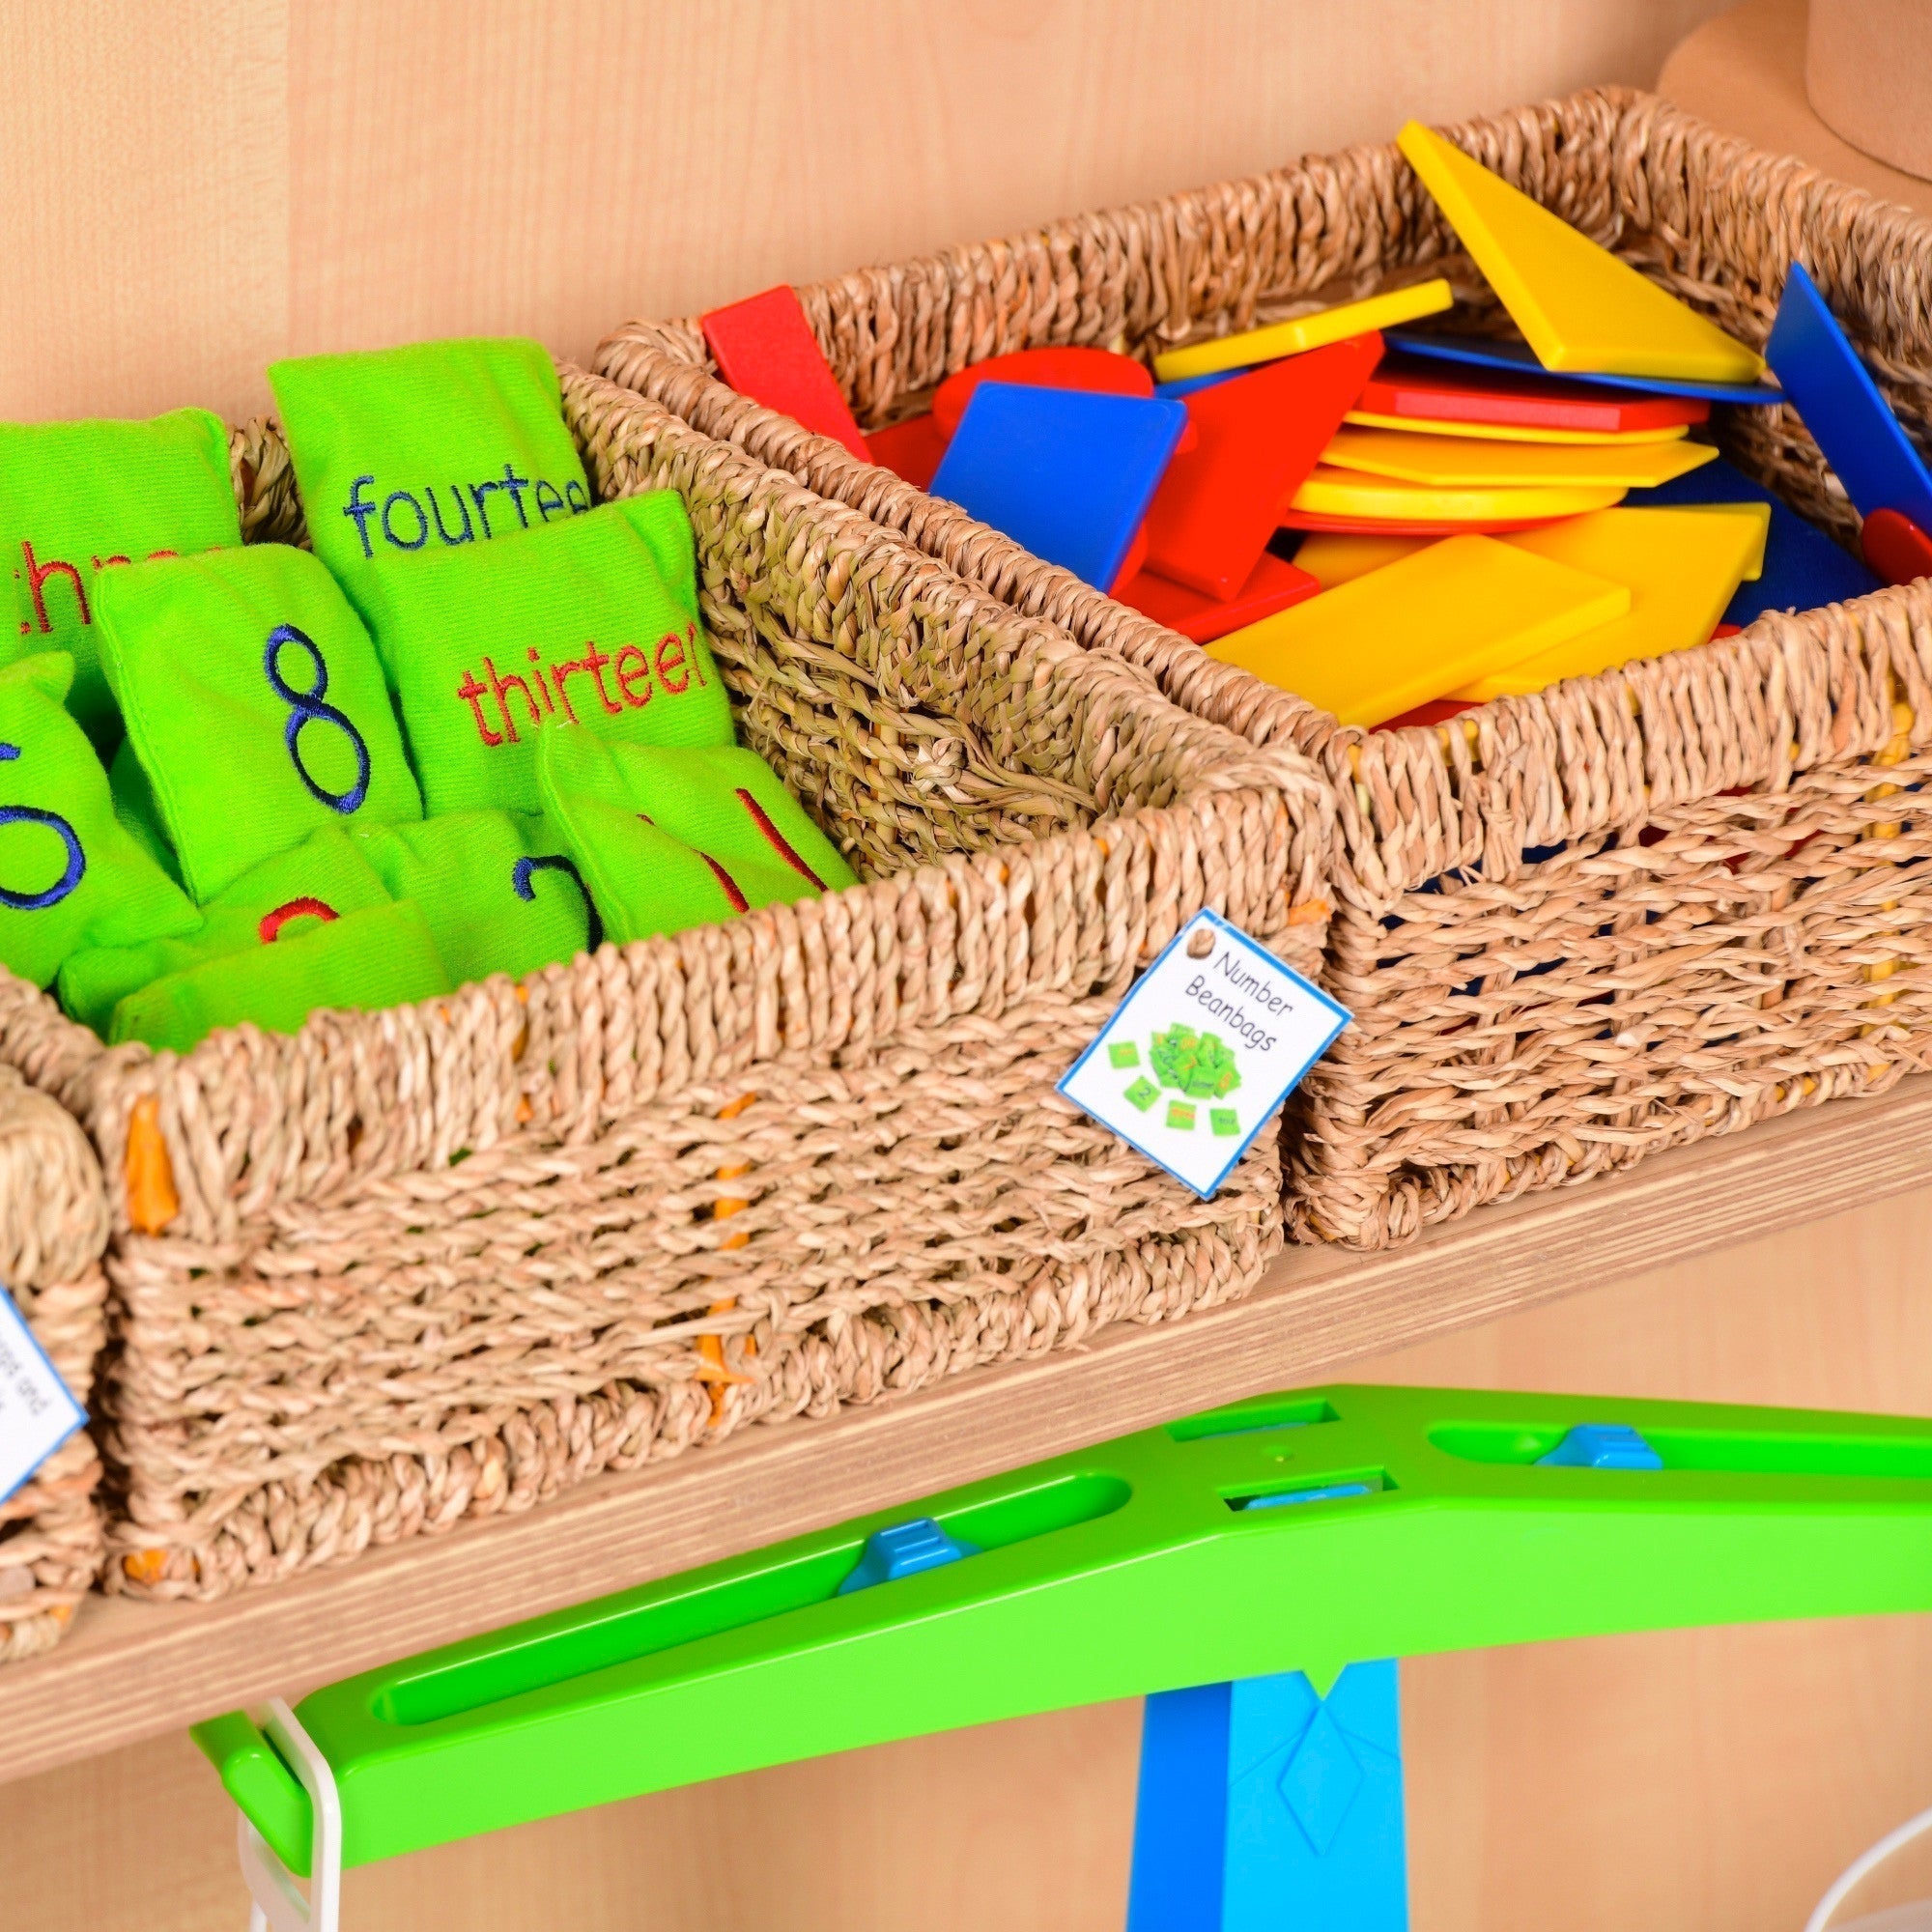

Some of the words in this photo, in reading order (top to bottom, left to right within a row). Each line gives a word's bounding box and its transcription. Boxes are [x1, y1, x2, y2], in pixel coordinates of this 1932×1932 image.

[264, 623, 371, 814] 8
[1185, 975, 1277, 1052] Beanbags
[1213, 951, 1293, 1016] Number
